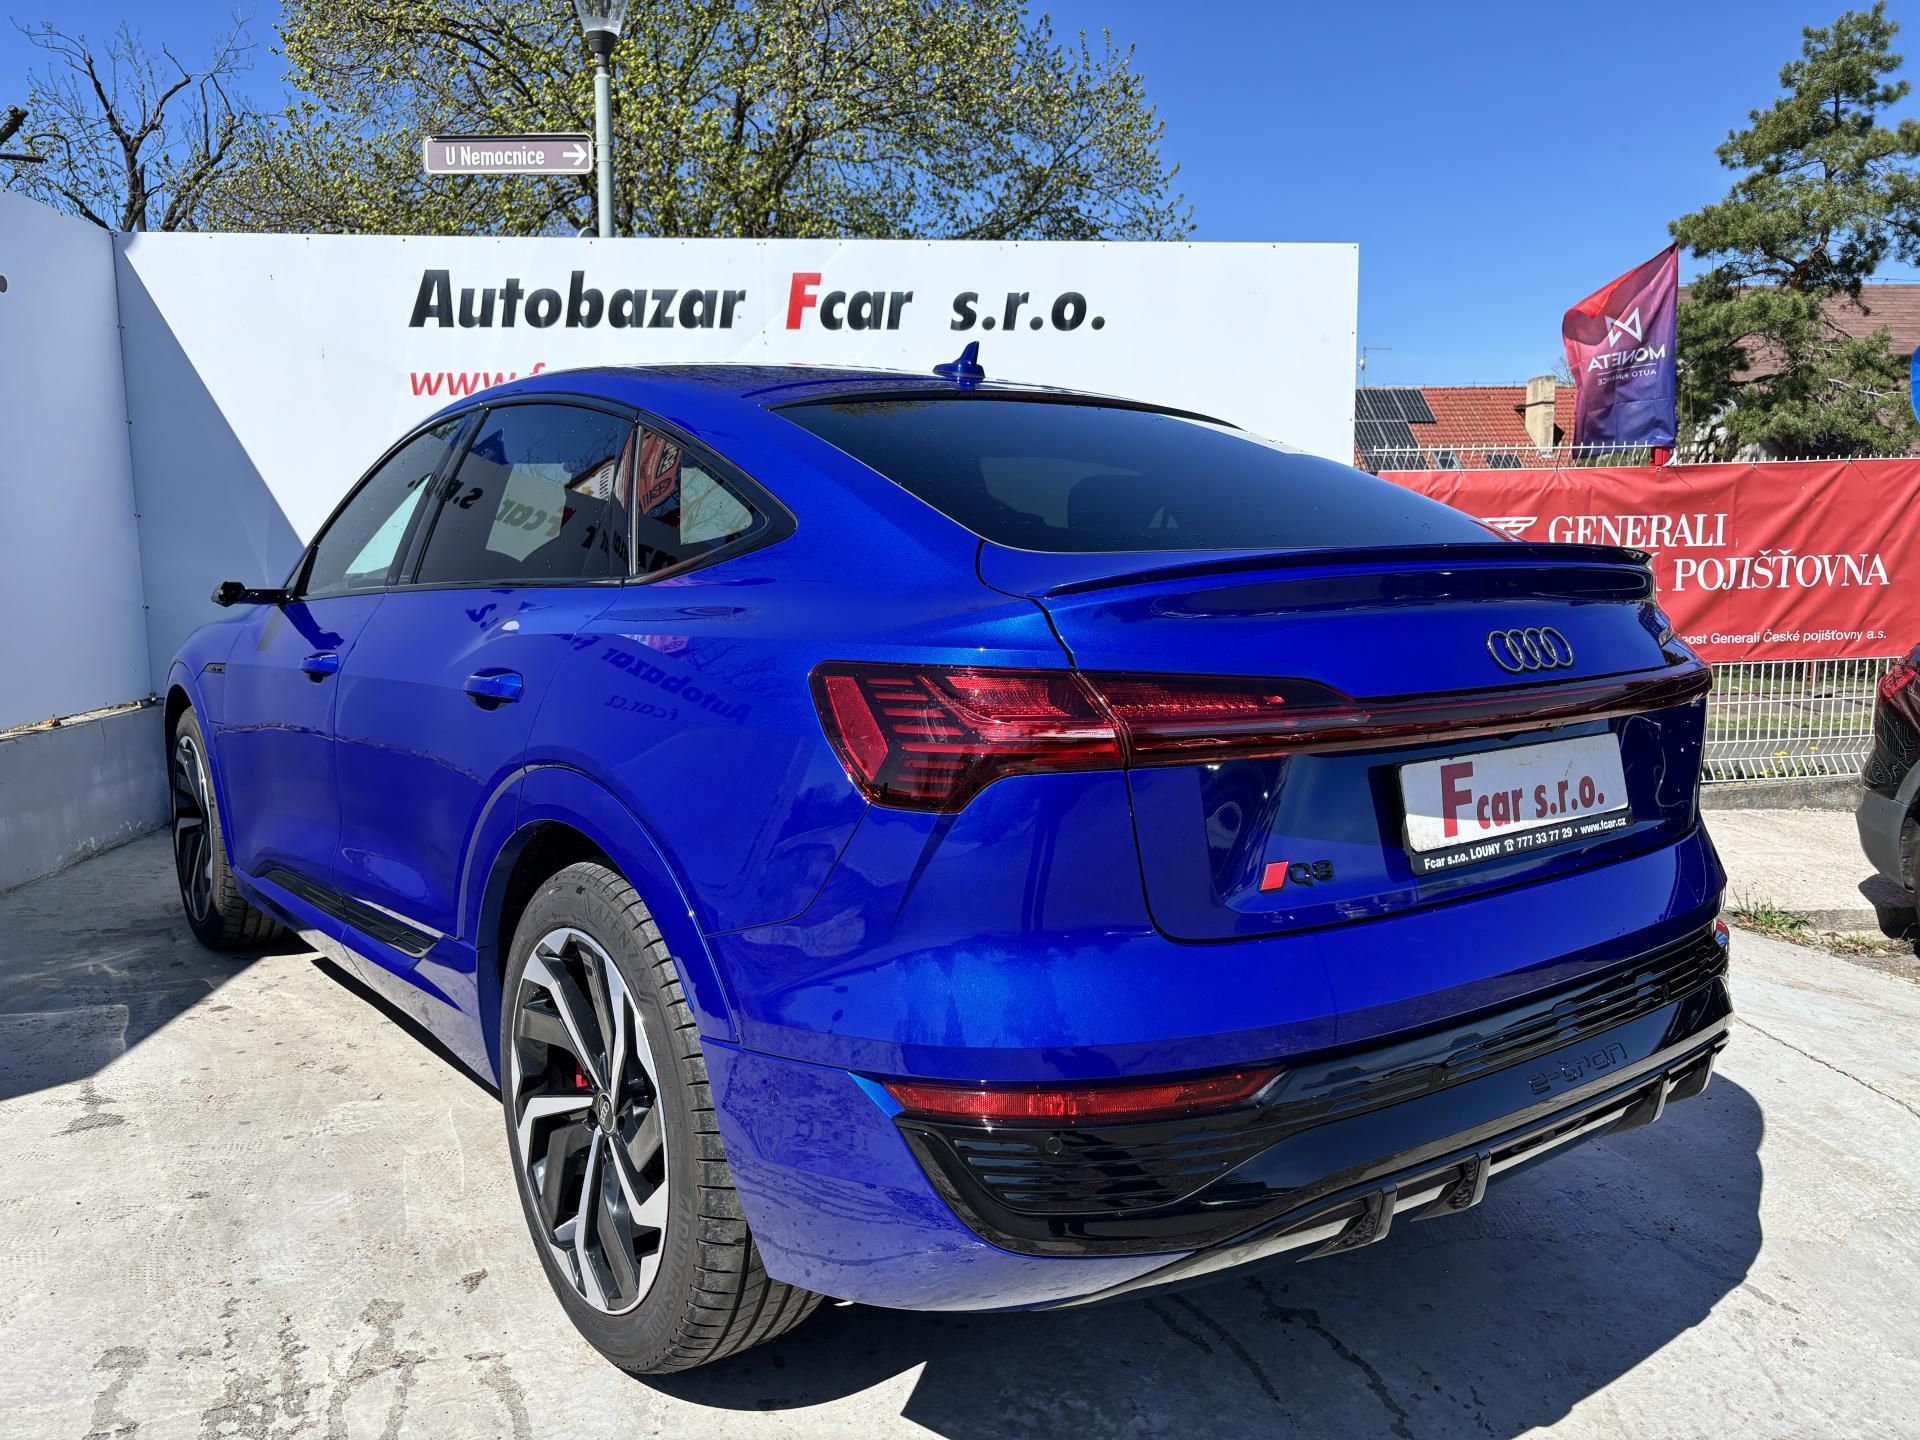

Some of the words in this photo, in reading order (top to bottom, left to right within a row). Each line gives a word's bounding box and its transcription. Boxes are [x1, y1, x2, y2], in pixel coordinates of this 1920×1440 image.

[445, 146, 456, 166] U
[460, 145, 545, 166] Nemocnice
[408, 269, 747, 329] Autobazar
[786, 272, 914, 331] Fcar
[950, 291, 1106, 332] s.r.o.
[1548, 513, 1729, 548] GENERALI
[1671, 548, 1891, 592] POJIŠŤOVNA
[1680, 633, 1708, 645] nost
[1710, 631, 1760, 645] Generali
[1763, 628, 1800, 642] České
[1803, 628, 1863, 644] pojišťovny
[1866, 629, 1887, 640] a.s.
[1440, 761, 1524, 838] Fcar
[1534, 775, 1605, 818] s.r.o.
[1423, 857, 1446, 871] Fcar
[1447, 851, 1469, 865] s.r.o.
[1470, 842, 1500, 860] LOUNY
[1516, 836, 1534, 849] 777
[1535, 833, 1548, 845] 33
[1549, 831, 1560, 842] 77
[1561, 828, 1573, 839] 29
[1579, 816, 1627, 835] www.fcar.cz
[1289, 860, 1335, 887] Q8
